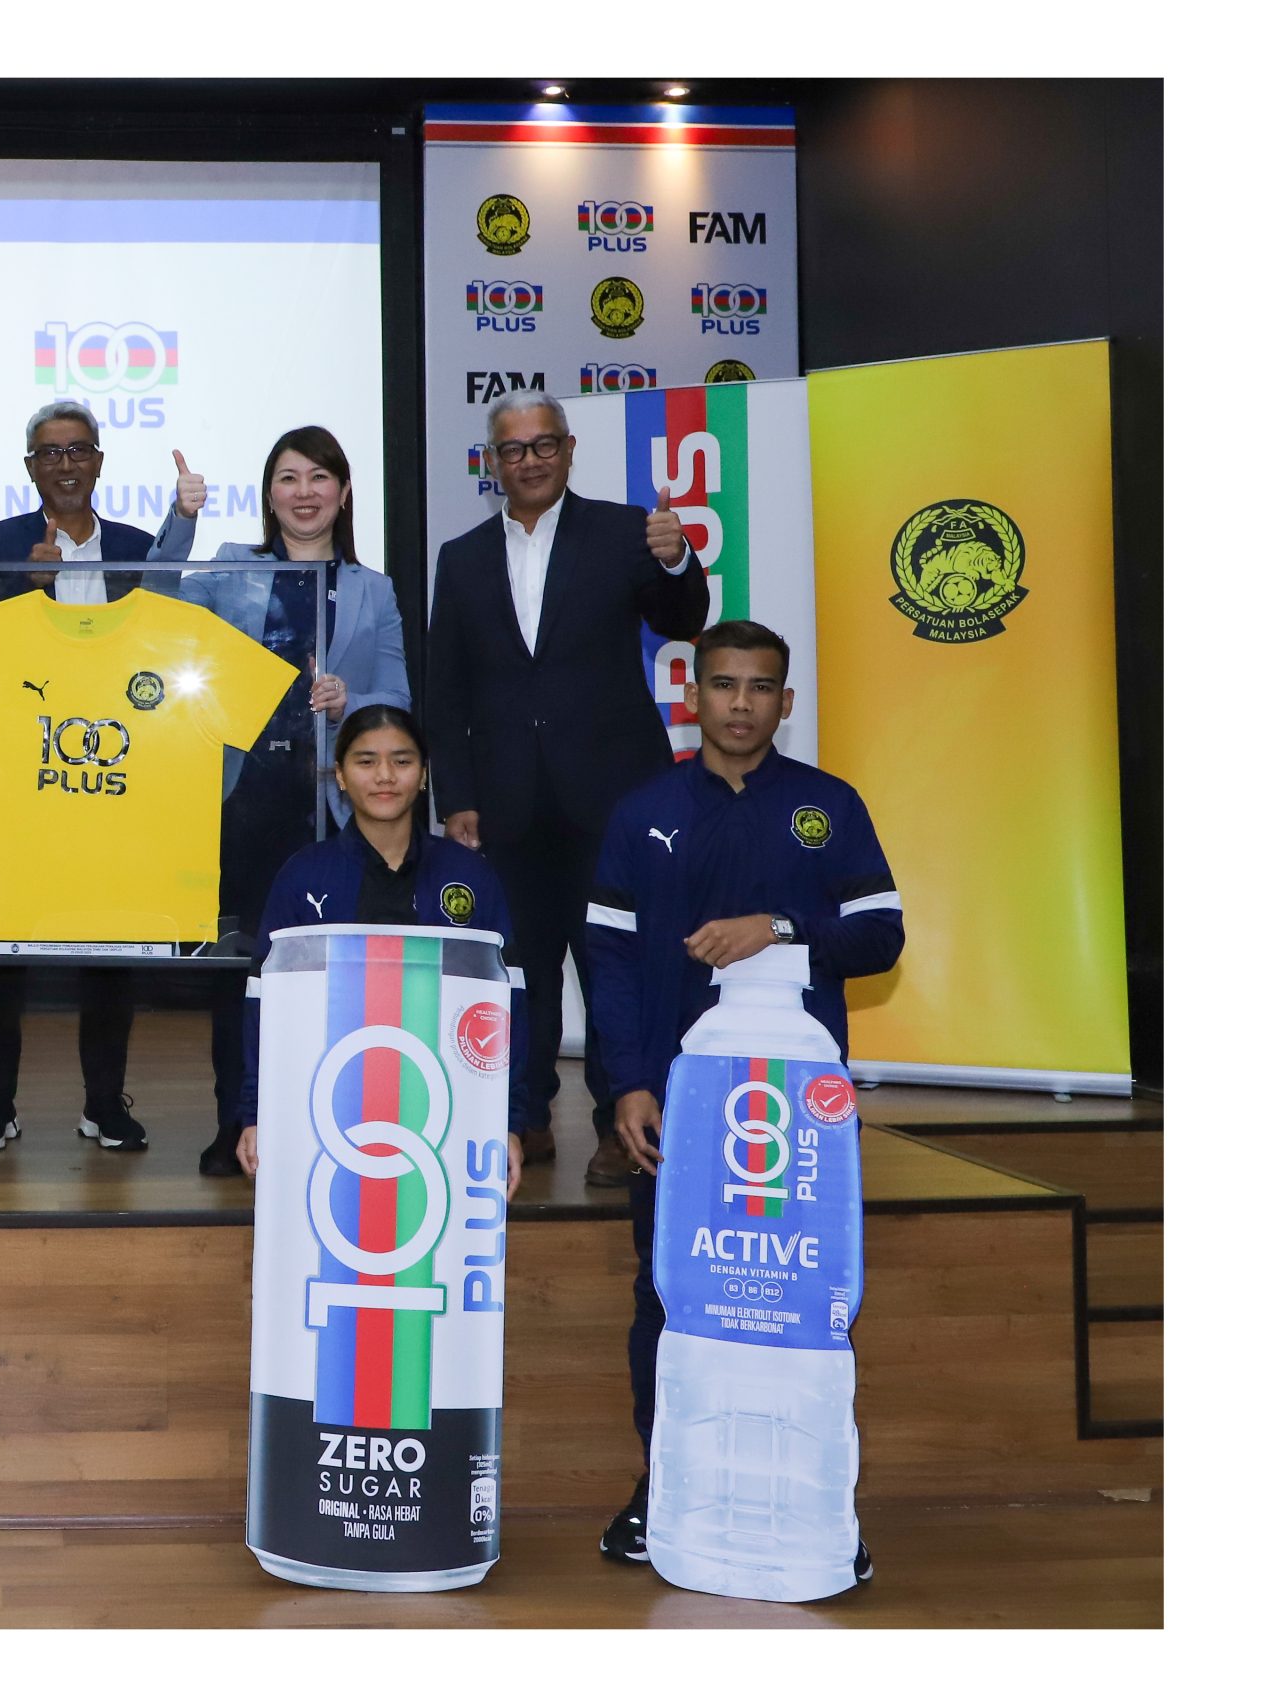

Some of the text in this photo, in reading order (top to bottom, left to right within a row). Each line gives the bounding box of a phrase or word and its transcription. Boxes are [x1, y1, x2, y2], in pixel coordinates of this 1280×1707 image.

[583, 200, 650, 235] 100
[688, 211, 767, 245] FAM
[588, 237, 647, 252] PLUS
[472, 279, 538, 316] 100
[696, 282, 762, 319] 100
[476, 316, 536, 333] PLUS
[701, 319, 761, 336] PLUS
[45, 321, 167, 394] 100
[585, 362, 651, 392] 100
[895, 592, 1021, 629] PERSATUAN BOLASEPAK
[928, 627, 988, 641] MALAYSIA
[37, 715, 131, 767] 100
[37, 768, 128, 796] PLUS
[458, 1035, 480, 1067] PILIHAN
[723, 1080, 792, 1204] 100
[307, 1024, 451, 1329] 100
[796, 1127, 819, 1202] PLUS
[463, 1138, 507, 1313] PLUS
[690, 1226, 820, 1269] ACTIVE
[710, 1264, 798, 1281] DENGAN VITAMIN B
[728, 1283, 780, 1297] B3 B6 B12
[704, 1303, 801, 1324] MINUMAN ELEKTROLIT ISOTONIK
[721, 1318, 785, 1334] TIDAK BERKARBONAT
[317, 1432, 426, 1473] ZERO
[319, 1471, 422, 1498] SUGAR
[475, 1493, 481, 1504] 0
[319, 1499, 421, 1522] ORIGINAL RASA HEBAT
[475, 1509, 491, 1522] 0%
[343, 1521, 395, 1541] TANPA GULA
